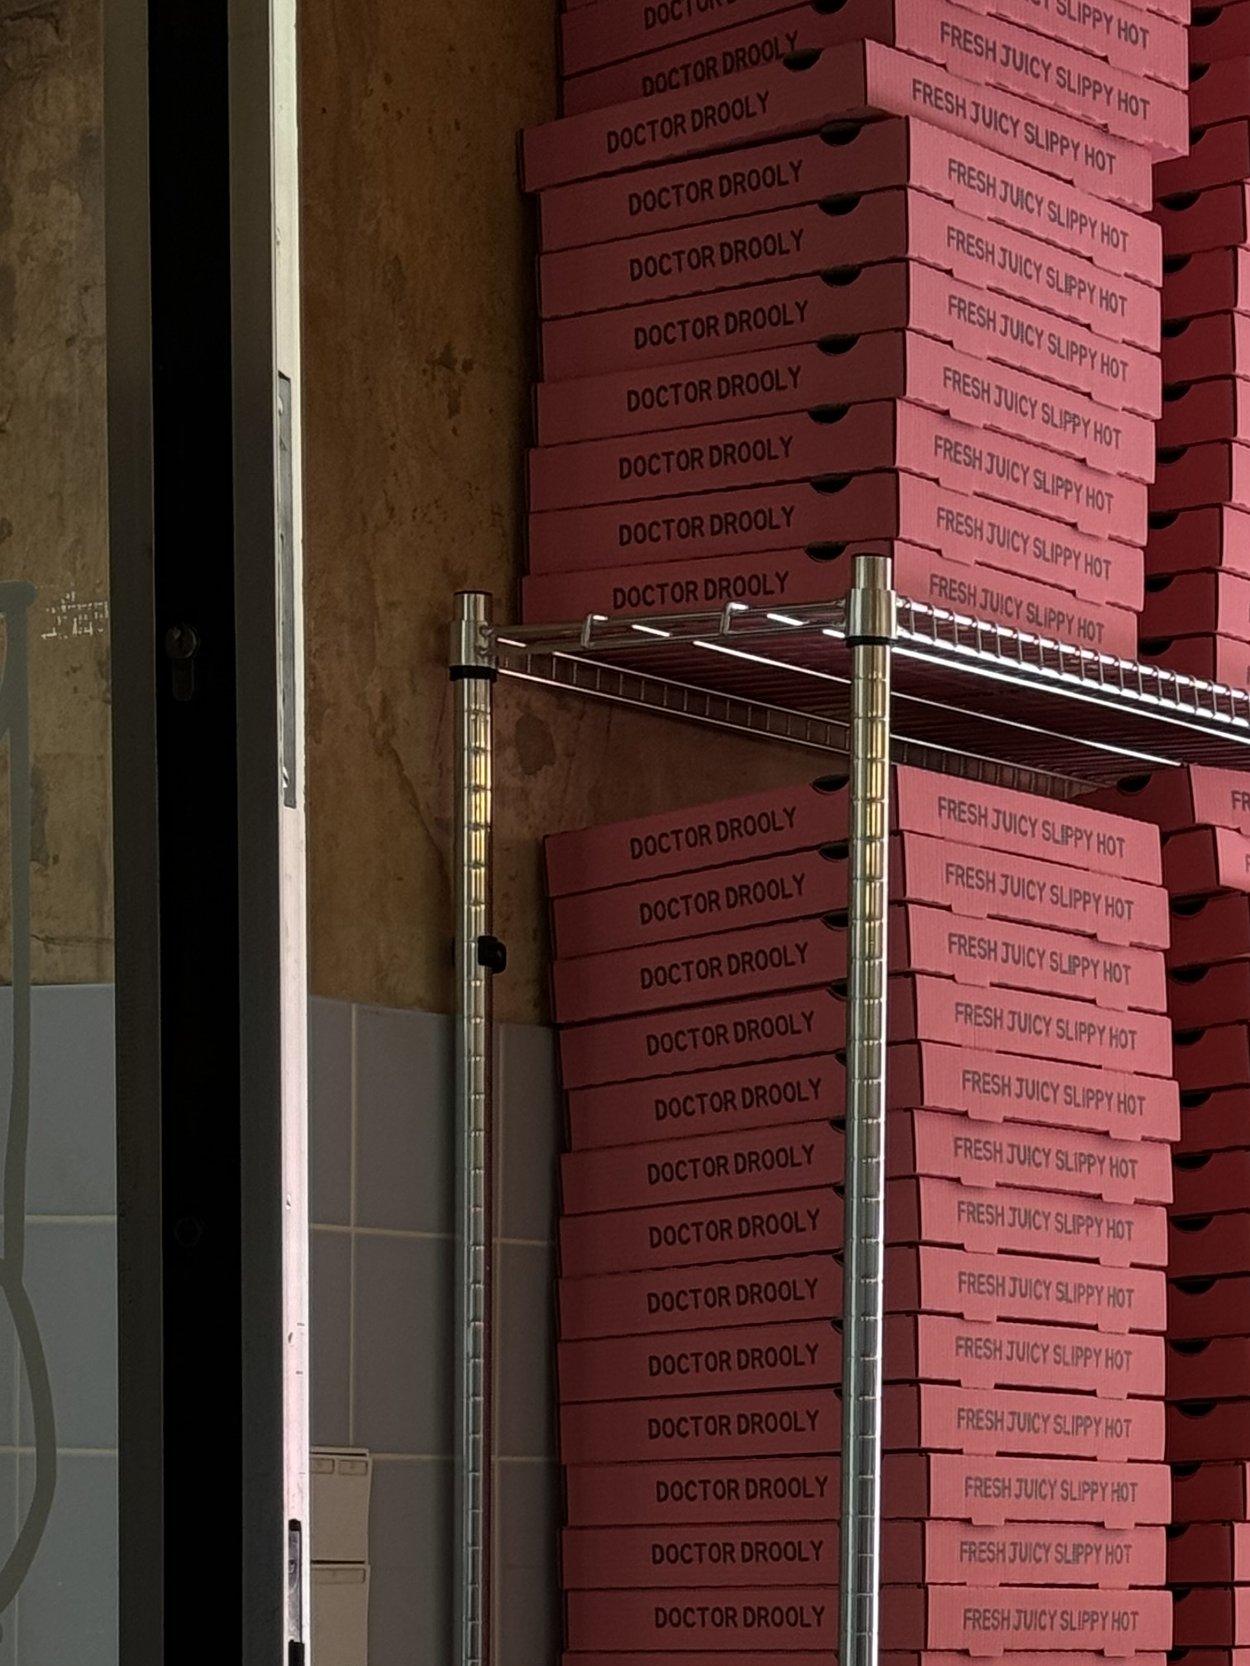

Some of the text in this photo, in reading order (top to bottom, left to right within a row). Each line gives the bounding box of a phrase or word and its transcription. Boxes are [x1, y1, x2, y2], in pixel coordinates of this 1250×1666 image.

[940, 19, 1152, 123] FRESH JUICY SLIPPY HOT
[606, 91, 769, 155] DOCTOR DROOLY
[912, 78, 1118, 177] FRESH JUICY SLIPPY HOT
[628, 160, 803, 217] DOCTOR DROOLY
[634, 300, 809, 350] DOCTOR DROOLY
[948, 293, 1130, 383] FRESH JUICY SLIPPY HOT
[618, 435, 794, 480] DOCTOR DROOLY
[936, 505, 1113, 582] FRESH JUICY SLIPPY HOT
[629, 806, 796, 860] DOCTOR DROOLY
[937, 794, 1127, 860] FRESH JUICY SLIPPY HOT
[639, 942, 808, 990] DOCTOR DROOLY
[654, 1077, 822, 1121] DOCTOR DROOLY
[961, 1069, 1147, 1117] FRESH JUICY SLIPPY HOT
[648, 1343, 820, 1377] DOCTOR DROOLY
[651, 1539, 824, 1565] DOCTOR DROOLY
